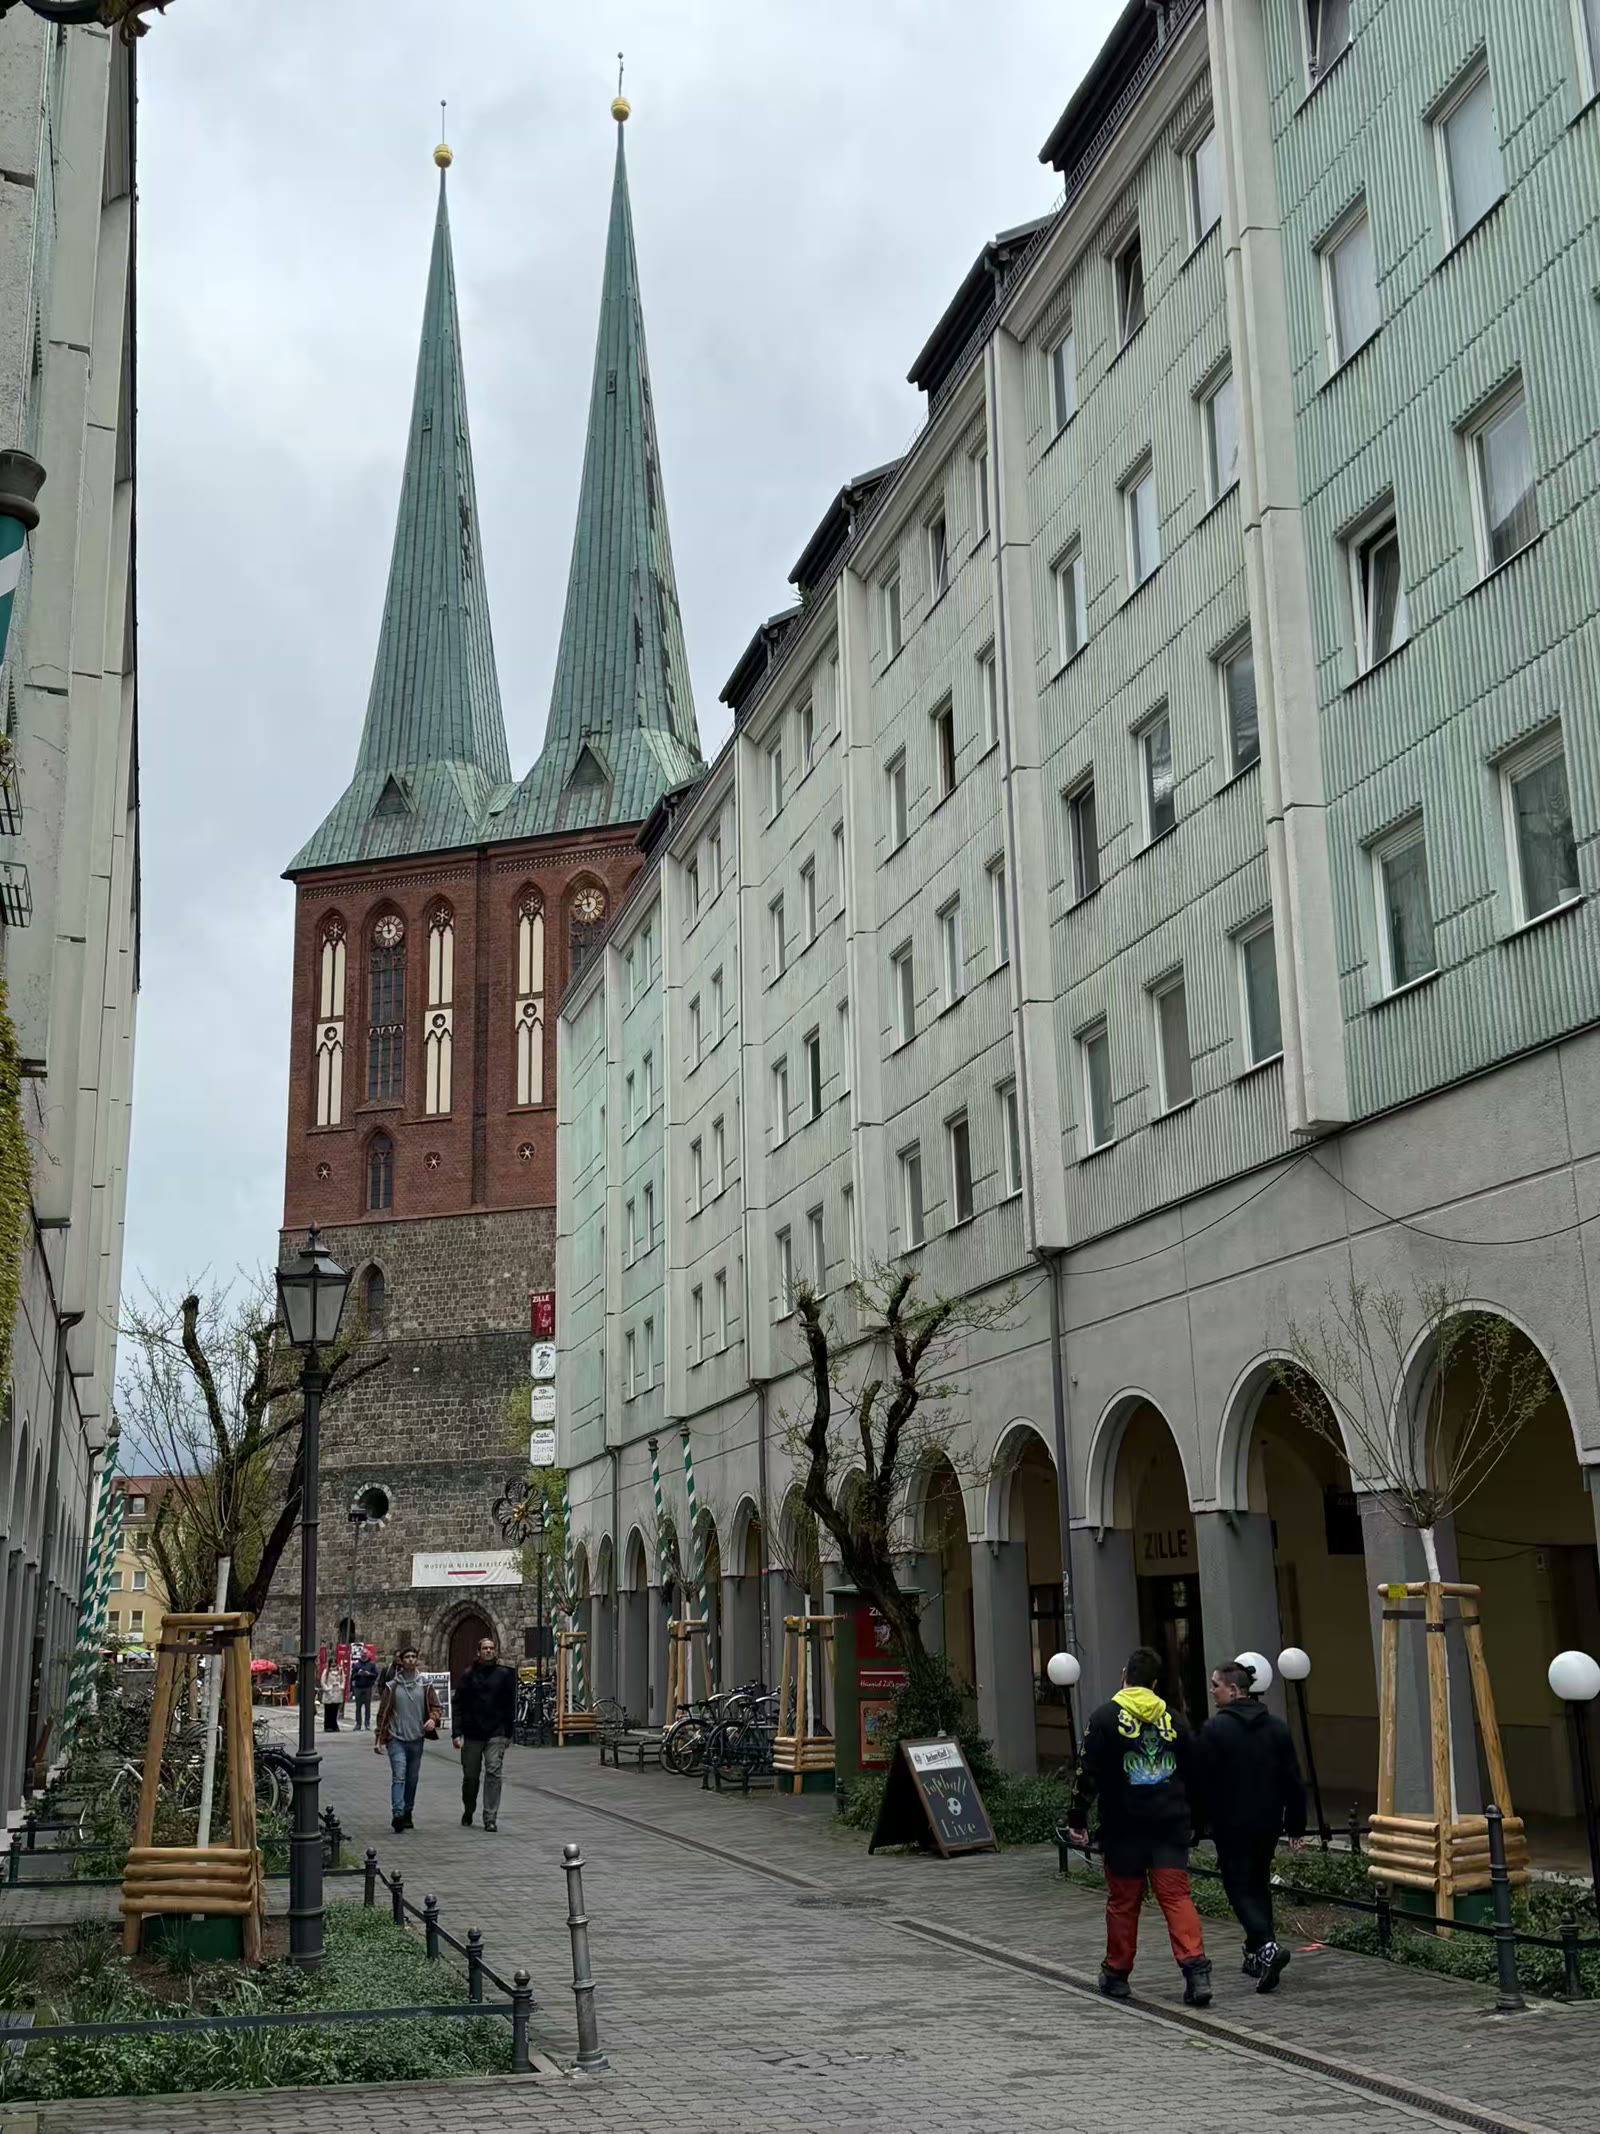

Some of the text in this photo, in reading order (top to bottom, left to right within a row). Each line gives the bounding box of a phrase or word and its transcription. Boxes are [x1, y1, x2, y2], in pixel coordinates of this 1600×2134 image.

[532, 1294, 550, 1303] ZILLE
[1143, 1529, 1188, 1560] ZILLE
[940, 1819, 976, 1838] Live
